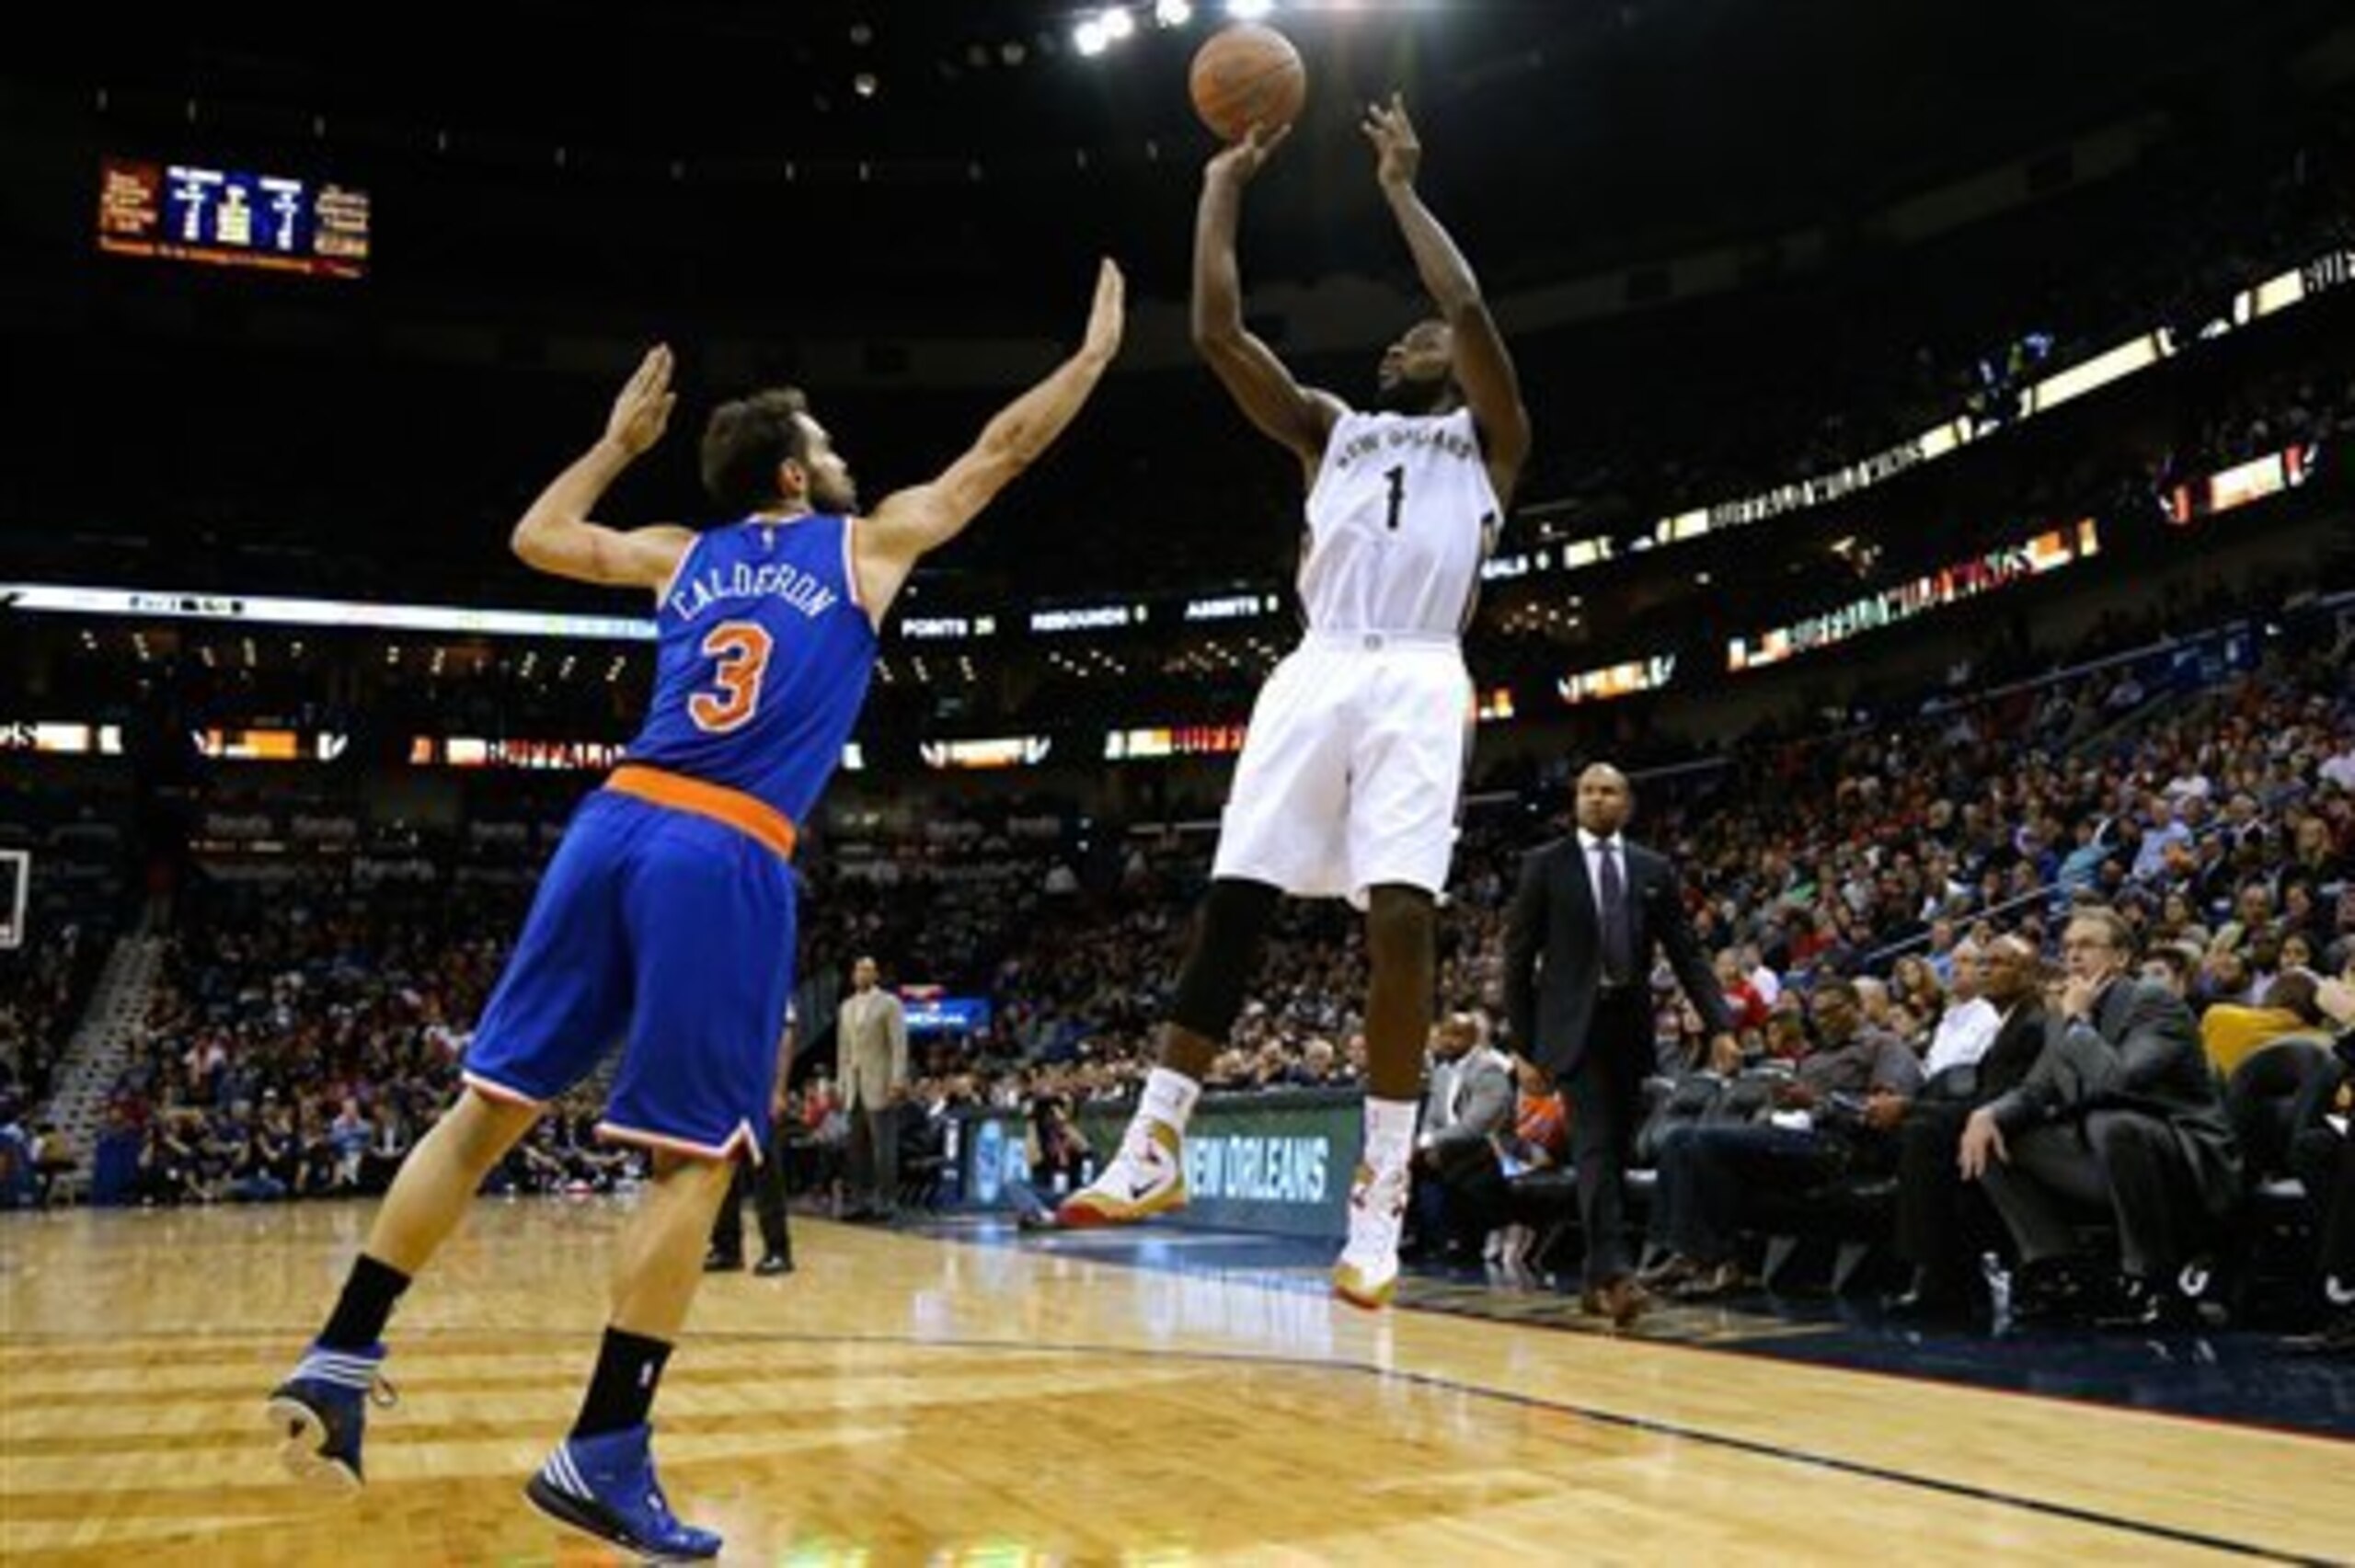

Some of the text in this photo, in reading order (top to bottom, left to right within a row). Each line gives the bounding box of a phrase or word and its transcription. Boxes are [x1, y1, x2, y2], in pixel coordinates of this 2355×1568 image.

[1383, 464, 1405, 531] 1
[671, 562, 837, 621] CALDERON
[901, 618, 968, 636] POINTS
[688, 620, 774, 731] 3
[1224, 1134, 1329, 1203] ORLEANS
